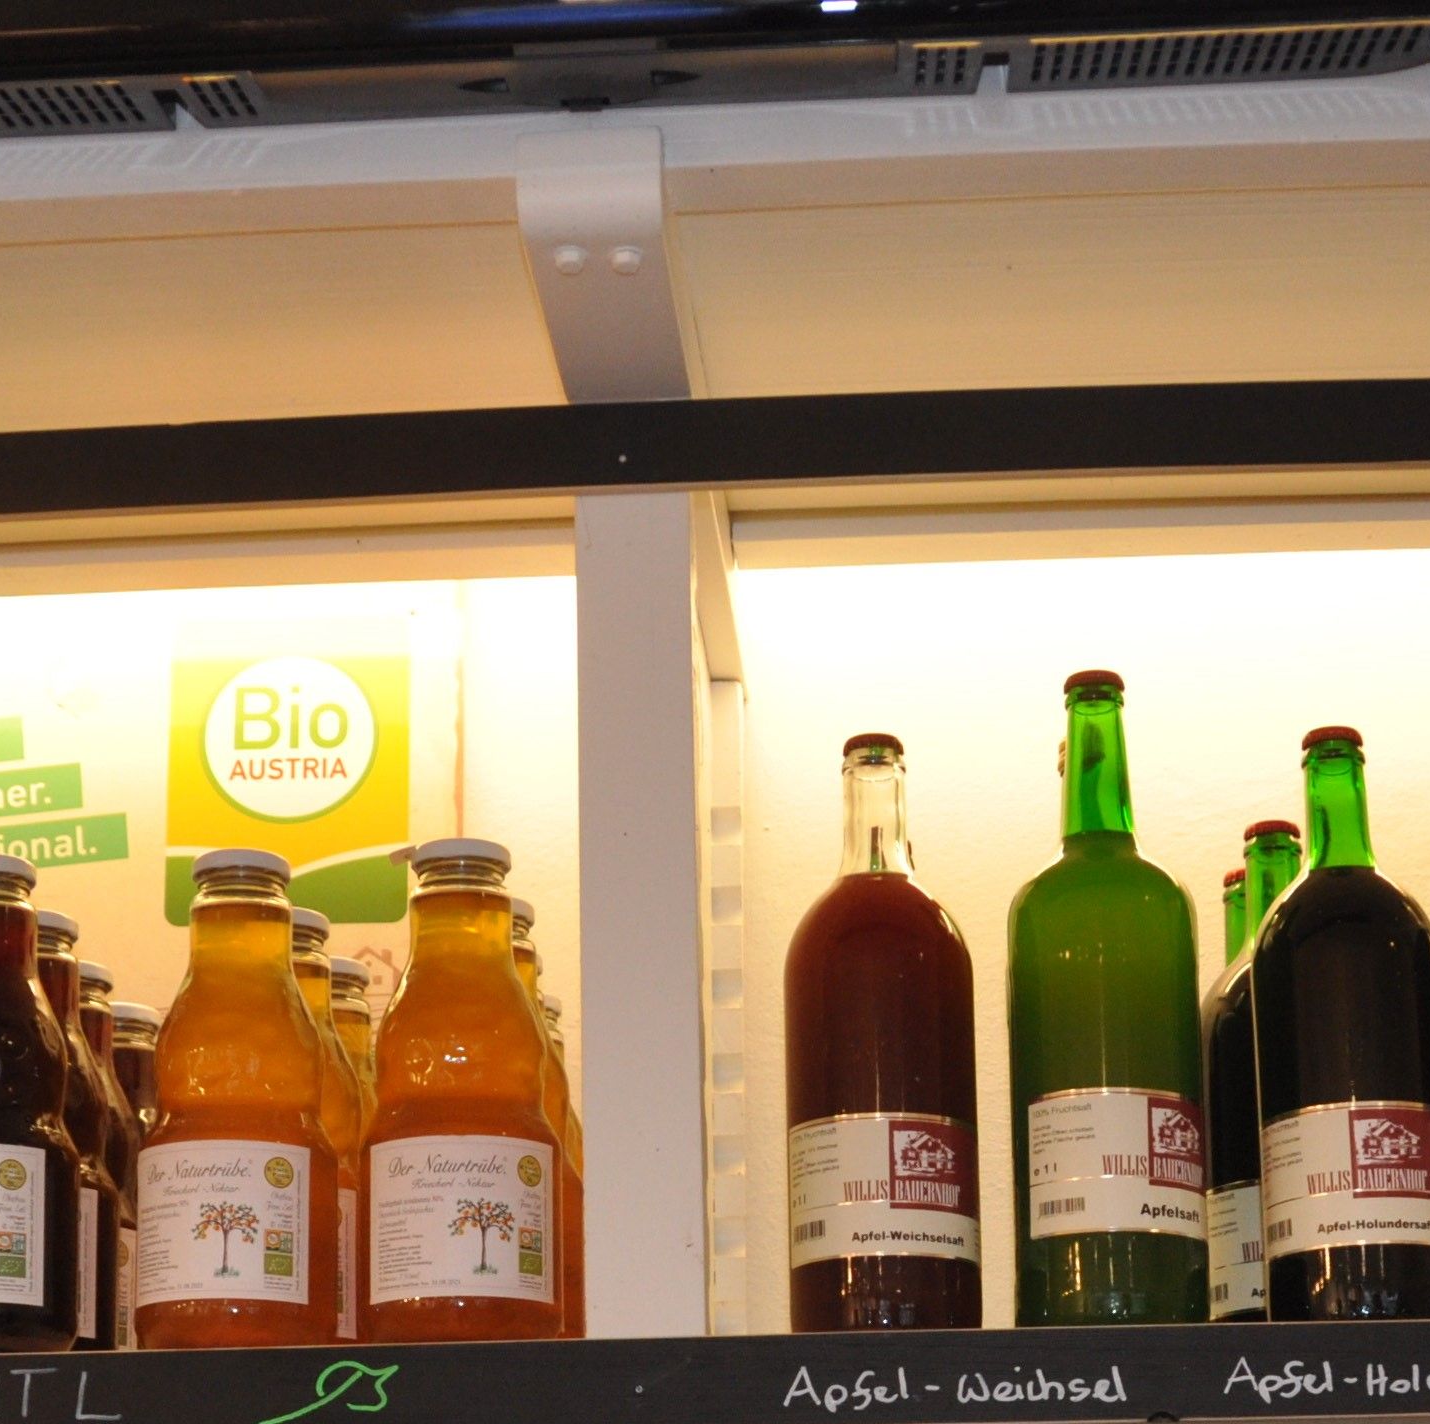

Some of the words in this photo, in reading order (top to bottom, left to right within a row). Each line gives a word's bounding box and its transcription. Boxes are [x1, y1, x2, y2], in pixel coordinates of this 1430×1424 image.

[233, 686, 349, 751] Bio
[229, 758, 348, 783] AUSTRIA
[1102, 1155, 1147, 1176] WILLIS
[843, 1179, 889, 1202] WILLIS
[895, 1181, 960, 1206] BAUERNHOF
[1307, 1171, 1351, 1195] WILLIS
[1358, 1169, 1428, 1190] BAUERNHOF
[1140, 1203, 1200, 1223] Apfelsaft
[852, 1231, 964, 1246] Apfel-Weichselsaft
